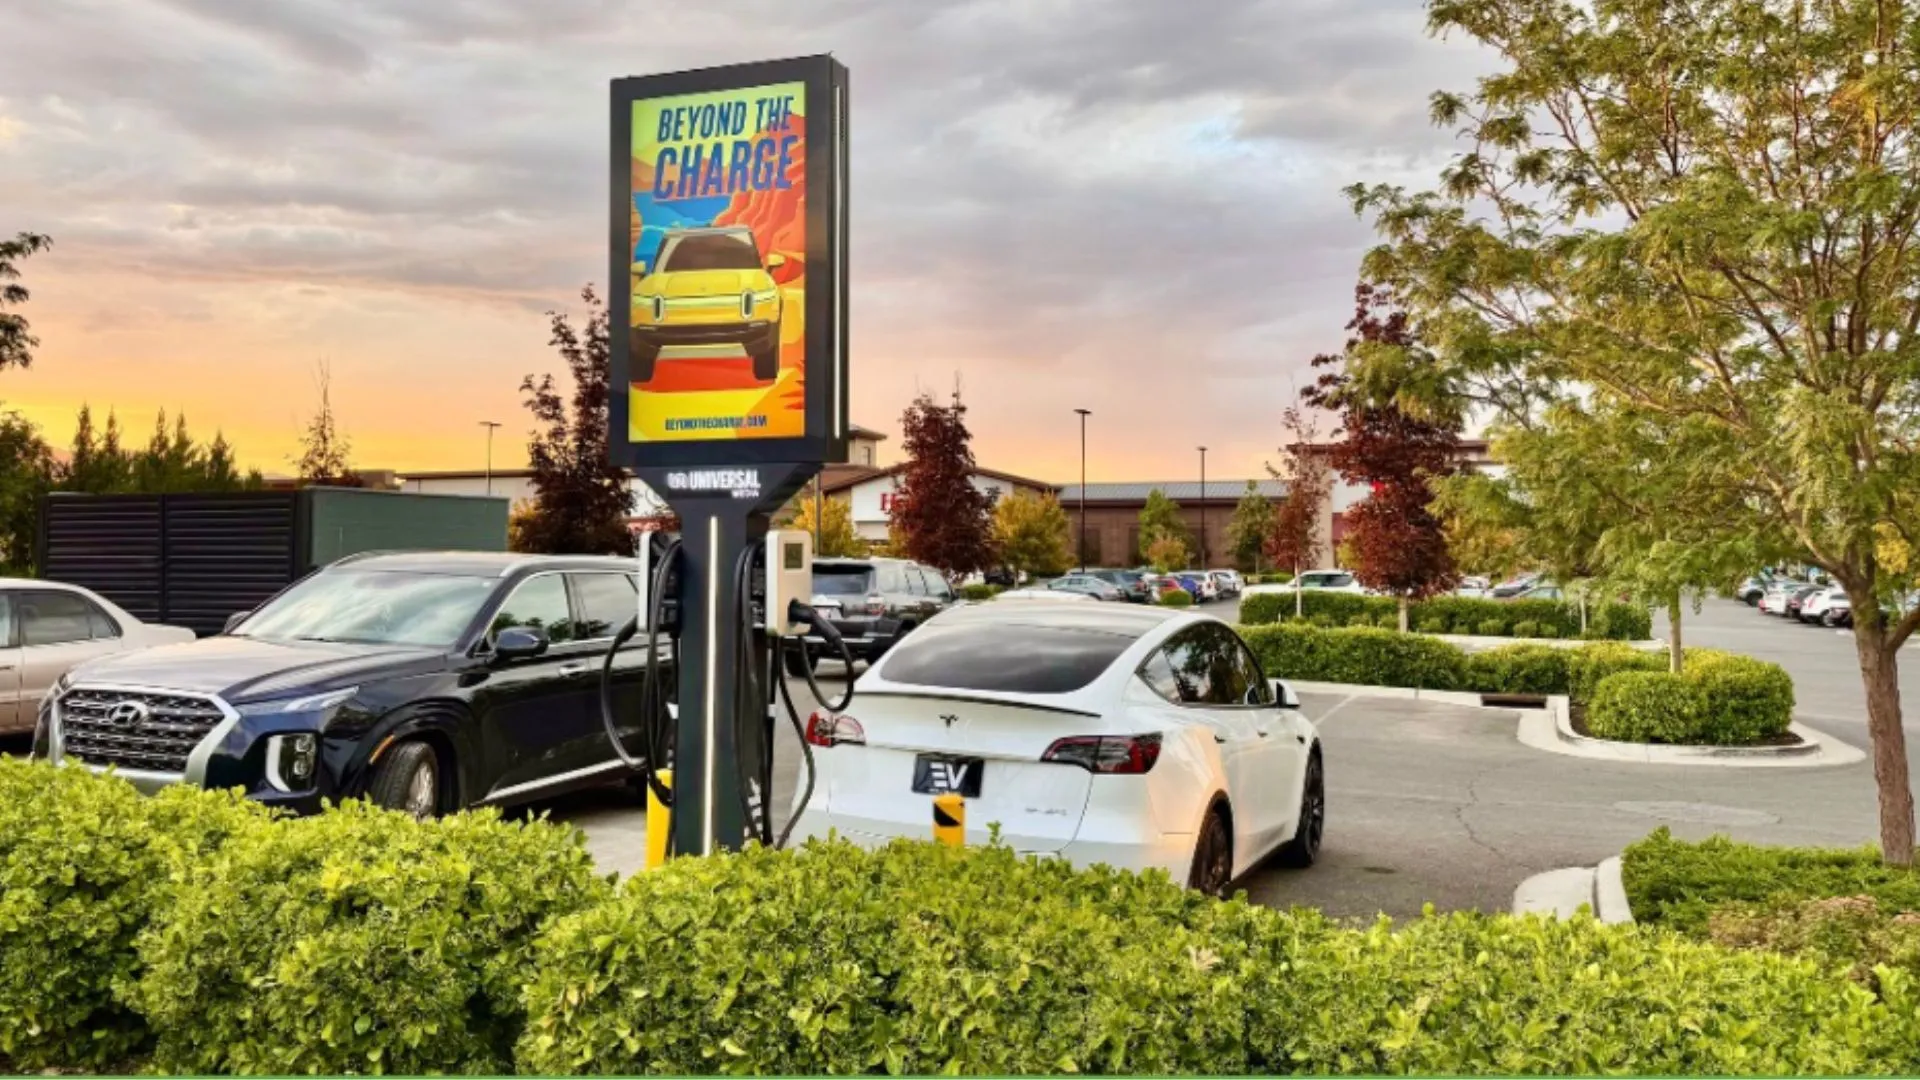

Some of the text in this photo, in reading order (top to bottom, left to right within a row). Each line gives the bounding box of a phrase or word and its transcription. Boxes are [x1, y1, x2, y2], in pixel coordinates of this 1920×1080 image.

[657, 96, 794, 143] BEYOND THE
[653, 135, 798, 199] CHARGE
[689, 469, 761, 490] UNIVERSAL
[929, 761, 968, 789] EV
